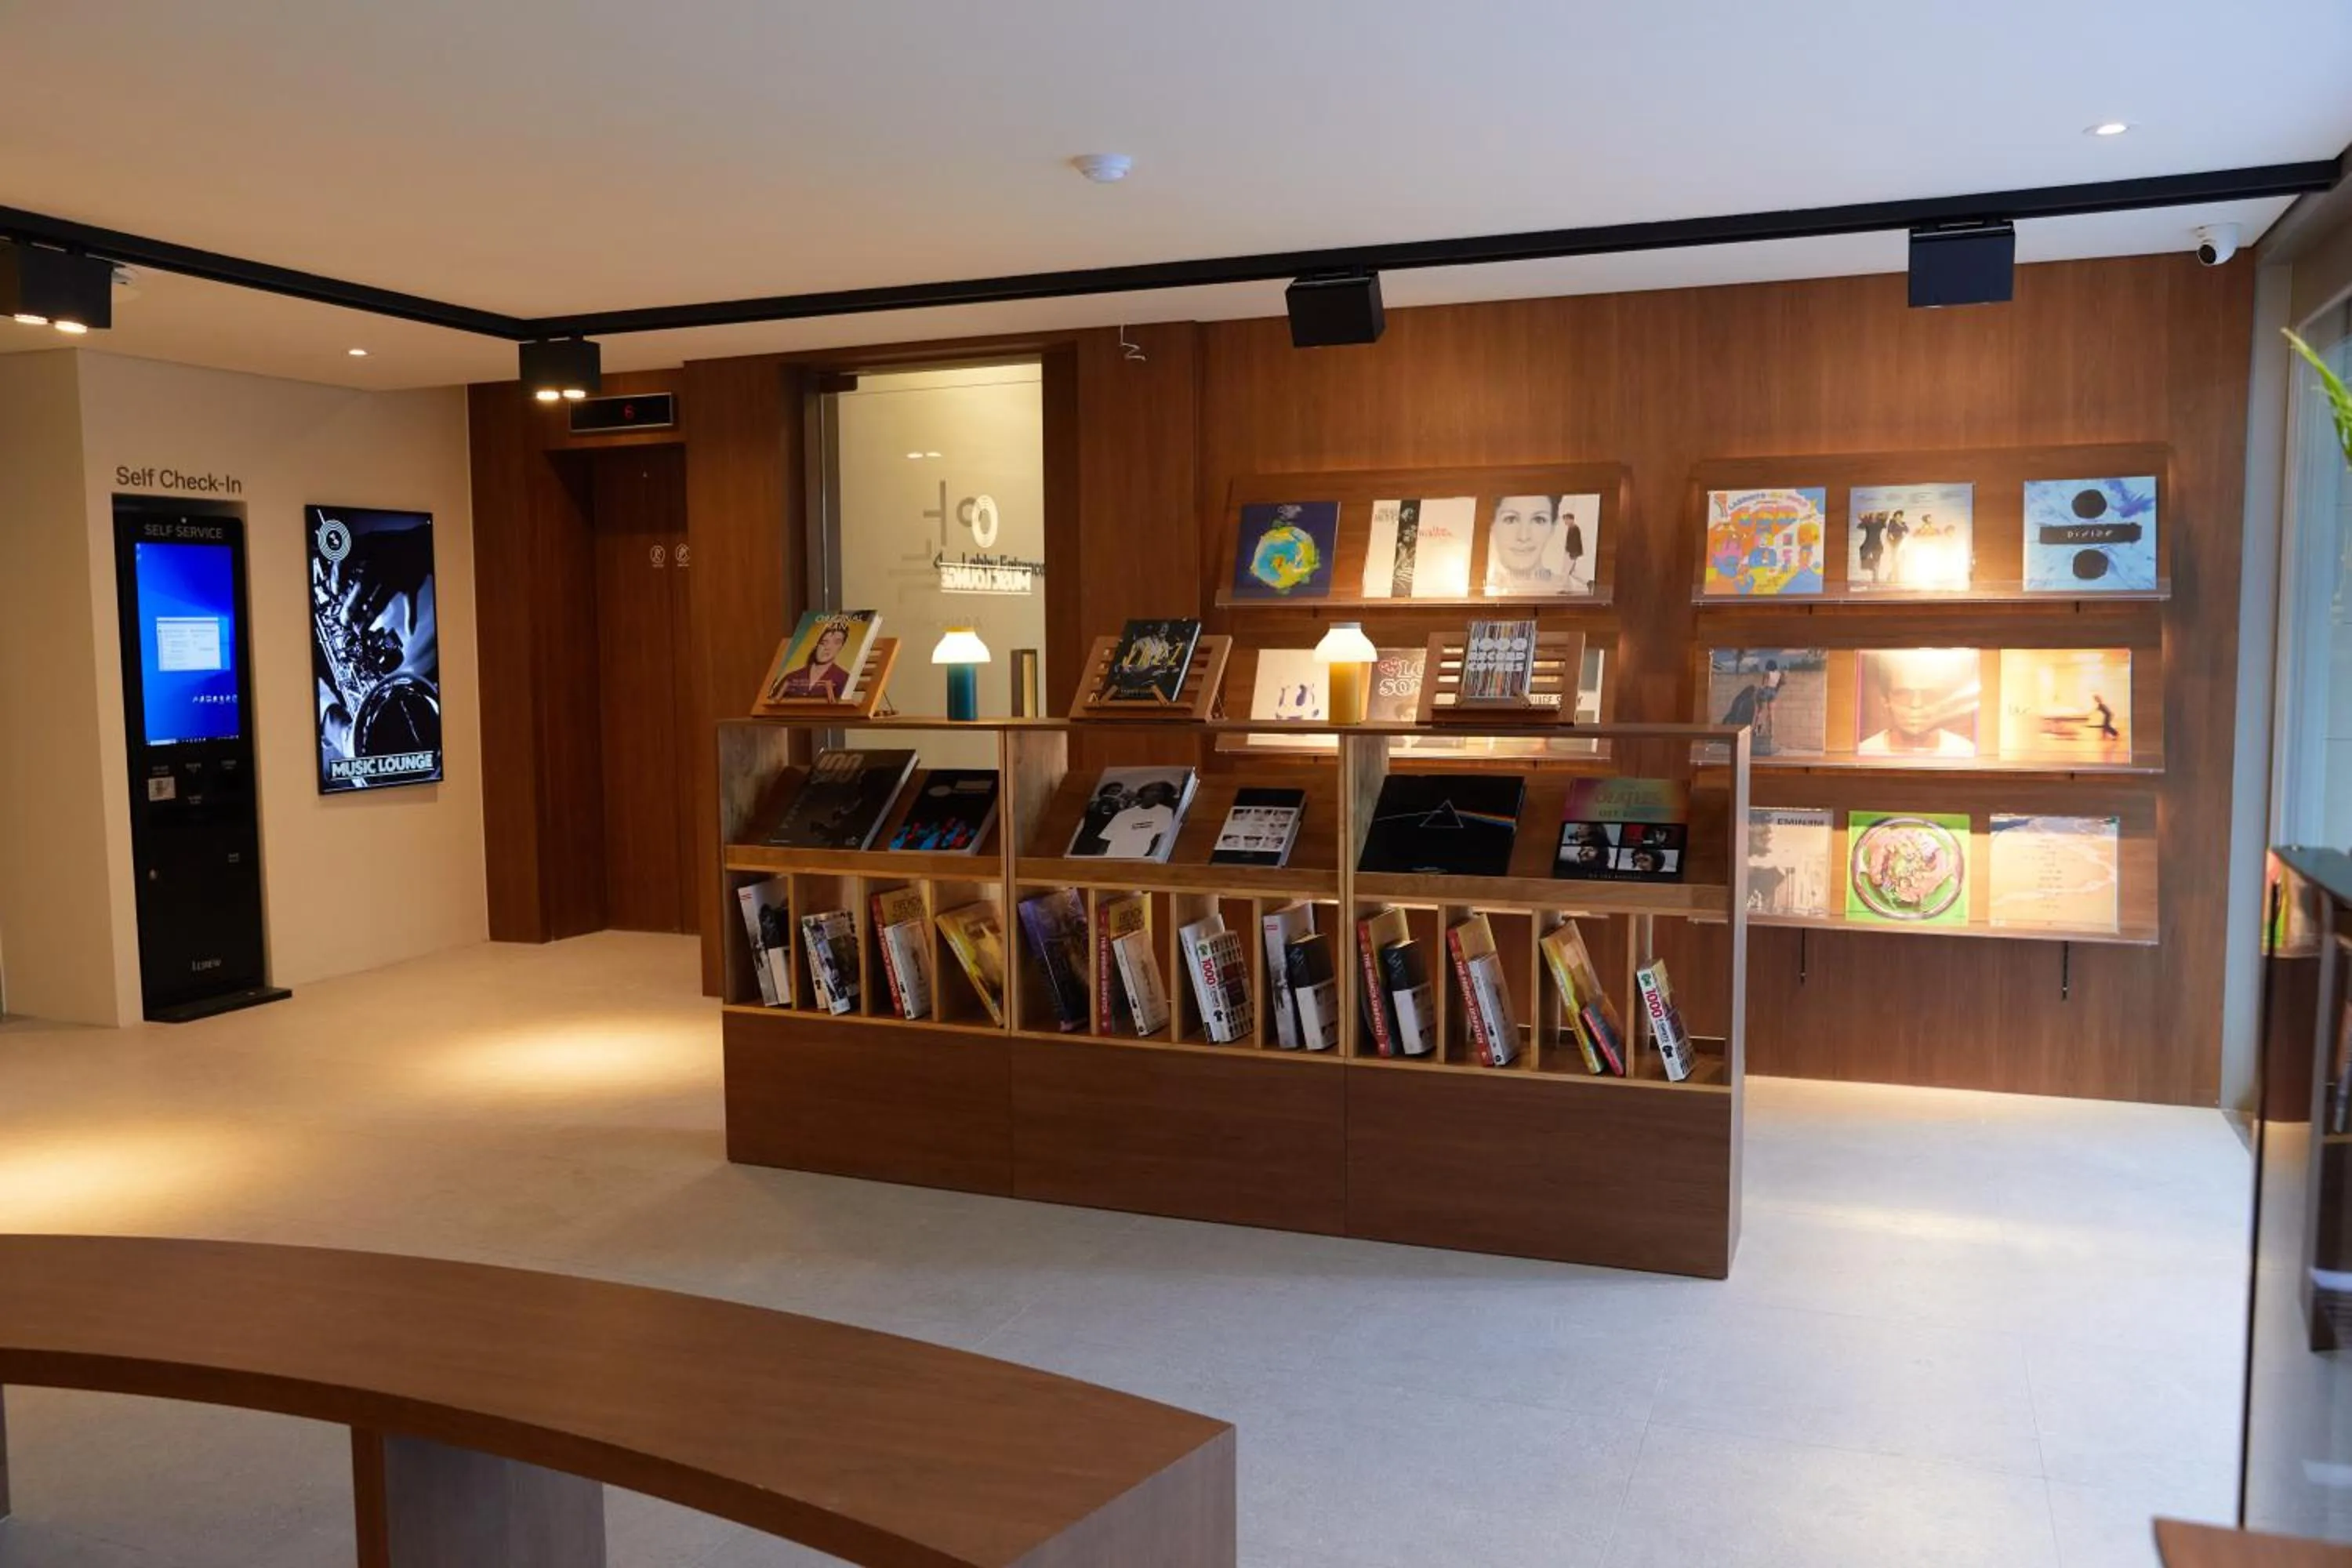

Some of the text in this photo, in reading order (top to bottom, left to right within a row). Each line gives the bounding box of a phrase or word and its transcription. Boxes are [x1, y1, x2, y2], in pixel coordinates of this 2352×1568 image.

[116, 466, 242, 493] Self Check-In
[143, 524, 223, 539] SELF SERVICE
[331, 752, 433, 778] MUSIC LOUNGE
[1201, 956, 1218, 986] 1000
[1645, 988, 1664, 1019] 1000
